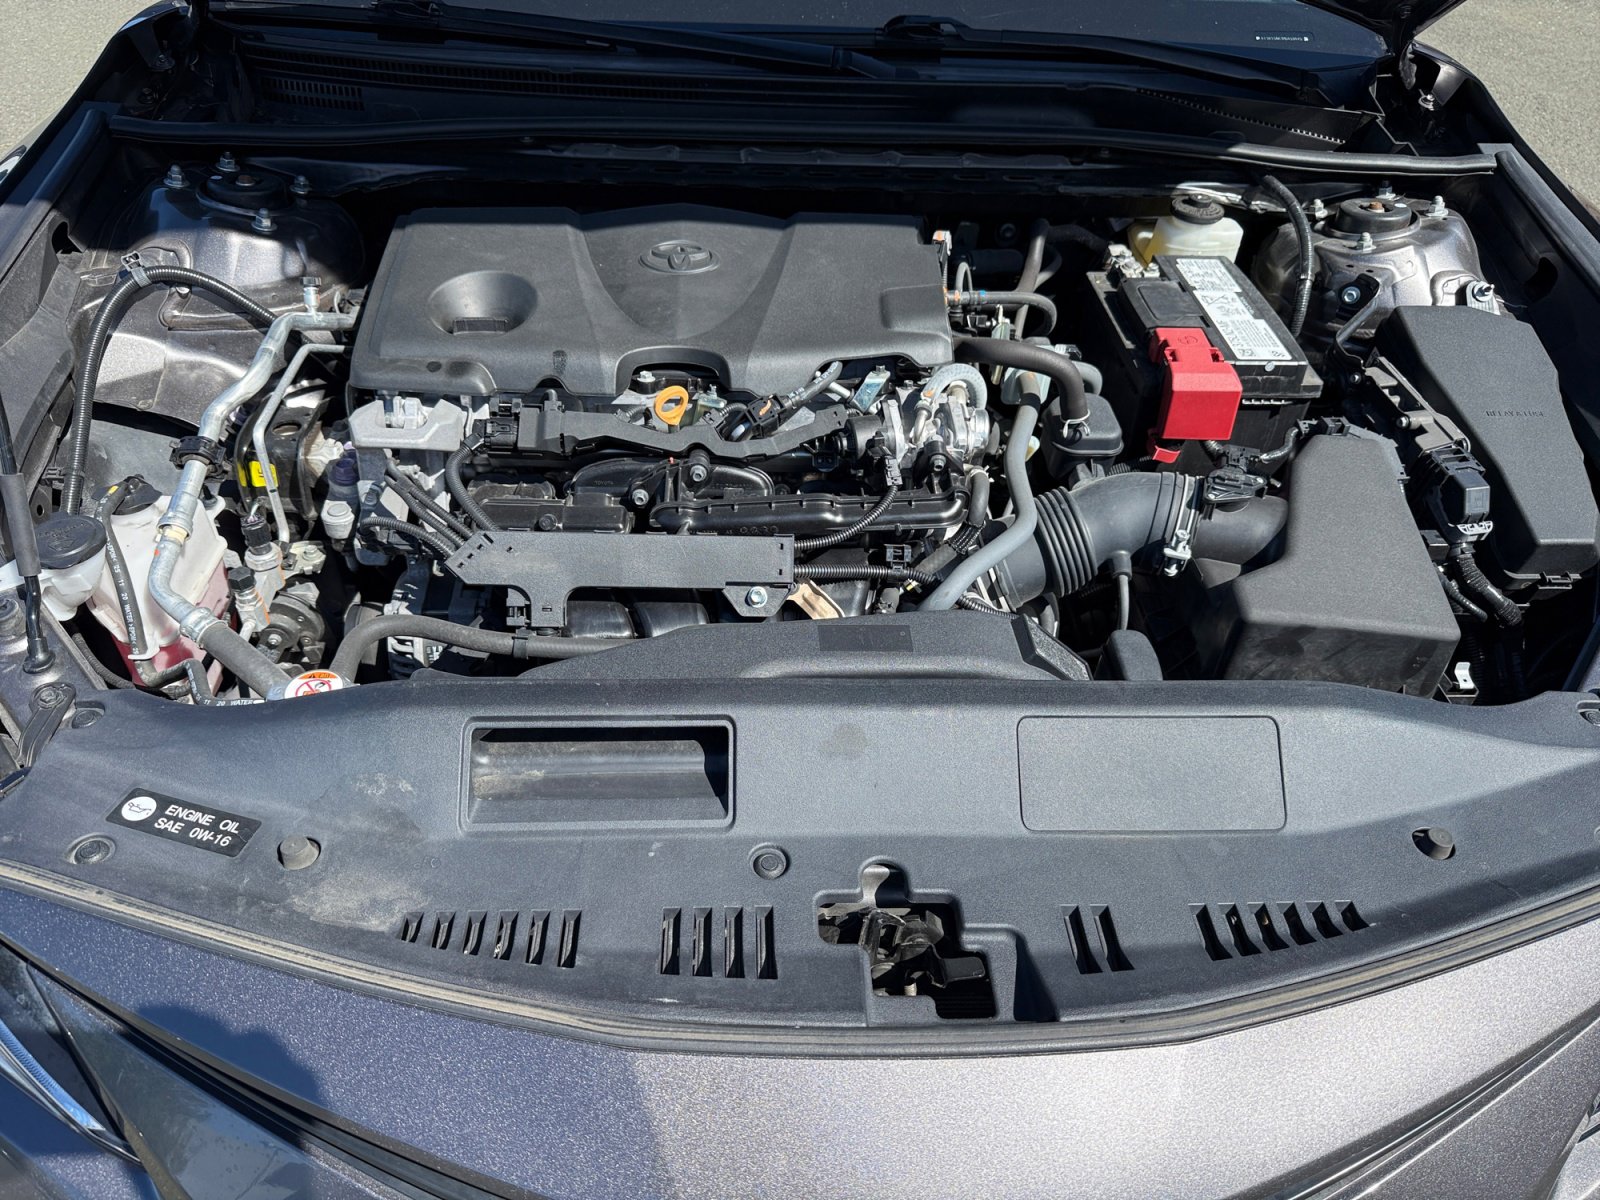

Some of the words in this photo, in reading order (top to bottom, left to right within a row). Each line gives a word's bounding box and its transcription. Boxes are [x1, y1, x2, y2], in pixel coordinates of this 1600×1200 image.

[124, 603, 134, 623] WATER
[154, 817, 185, 834] SAE
[189, 827, 232, 847] 0W-16
[165, 804, 216, 826] ENGINE
[219, 819, 241, 834] OIL
